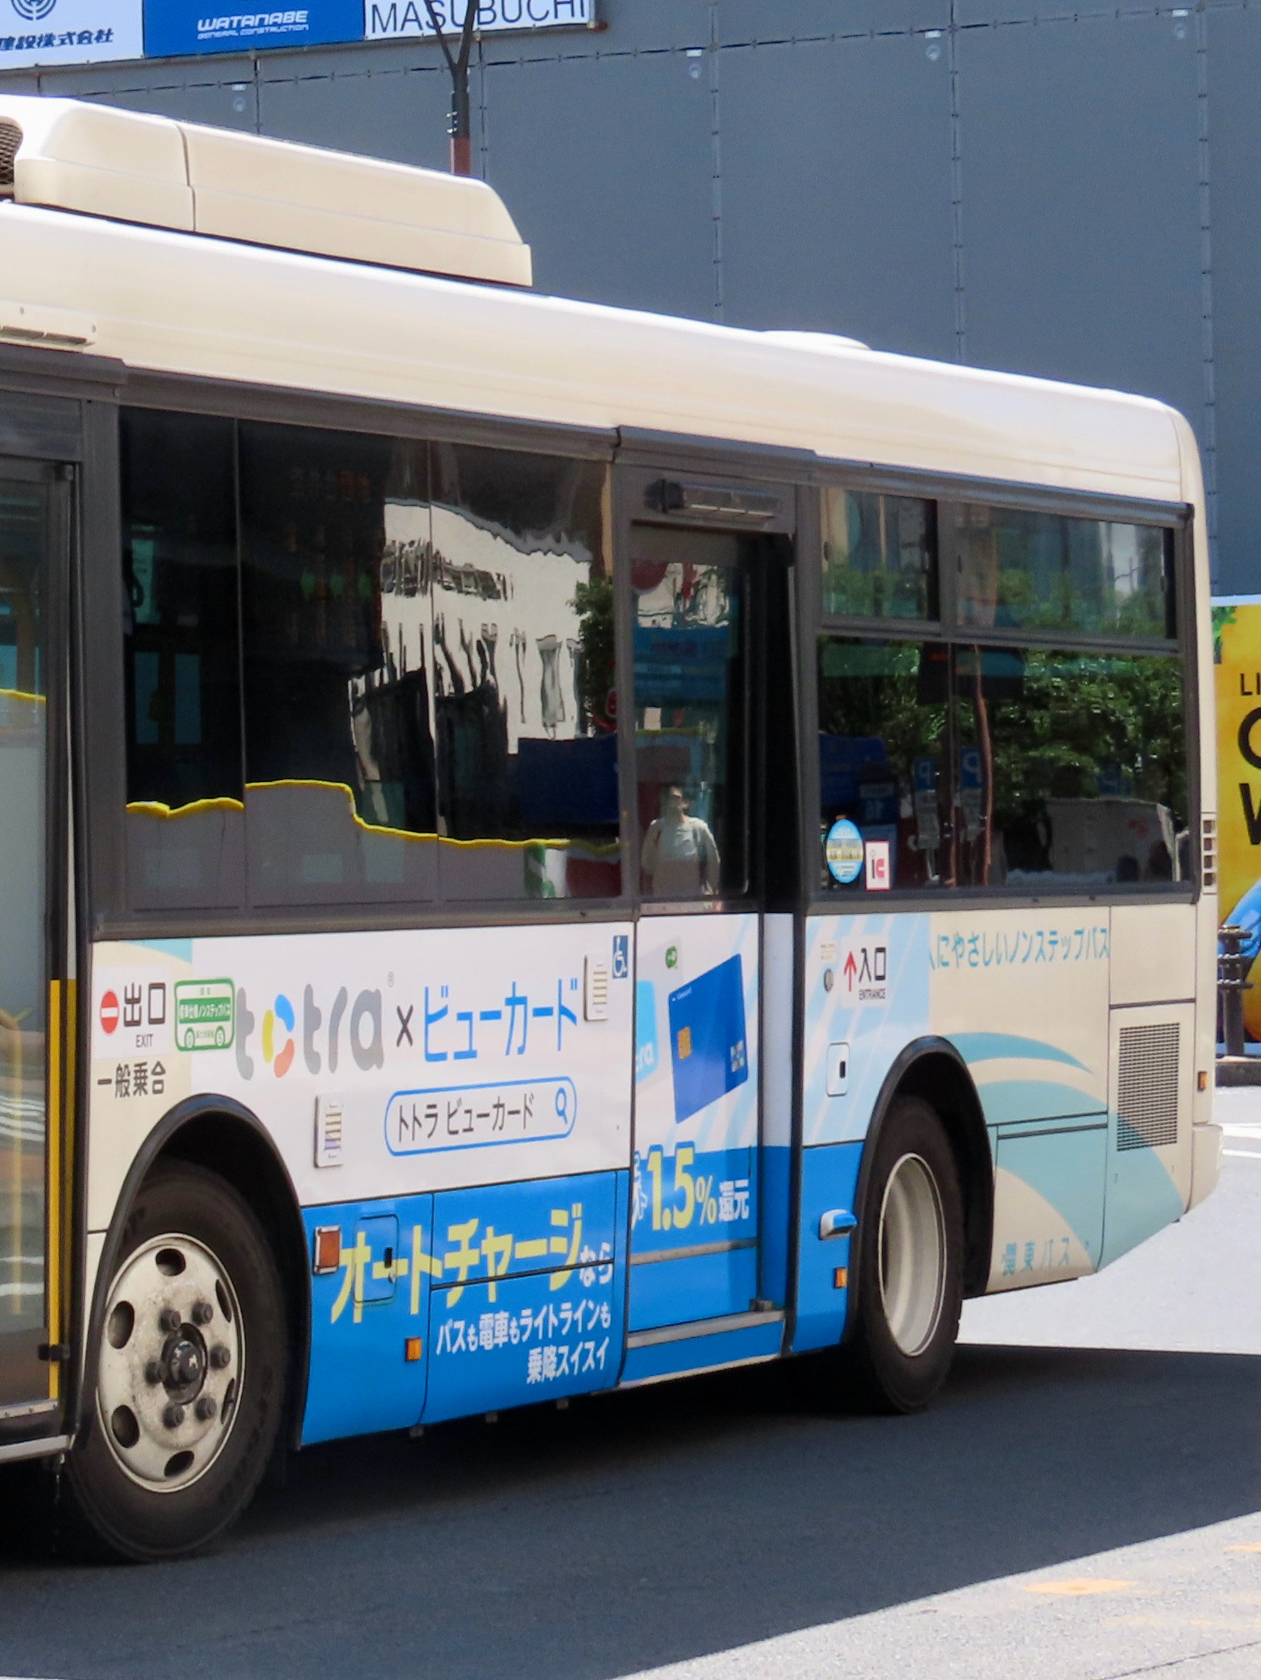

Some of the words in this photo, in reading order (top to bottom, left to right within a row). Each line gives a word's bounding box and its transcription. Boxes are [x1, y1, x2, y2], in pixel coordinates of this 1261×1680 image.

[197, 10, 309, 31] WATANABE
[240, 23, 309, 36] CONSTRUCTION
[858, 947, 887, 983] 入口
[123, 982, 166, 1027] 出口
[859, 988, 886, 1000] ENTRANCE
[424, 978, 579, 1062] ビューカード
[135, 1033, 153, 1048] EXIT
[97, 1061, 166, 1099] 一般乗合
[399, 1103, 439, 1143] トトラ
[447, 1092, 535, 1136] ビューカード
[436, 1300, 611, 1355] バスも電車もライトラインも
[526, 1336, 609, 1385] 乗降スイスイ
